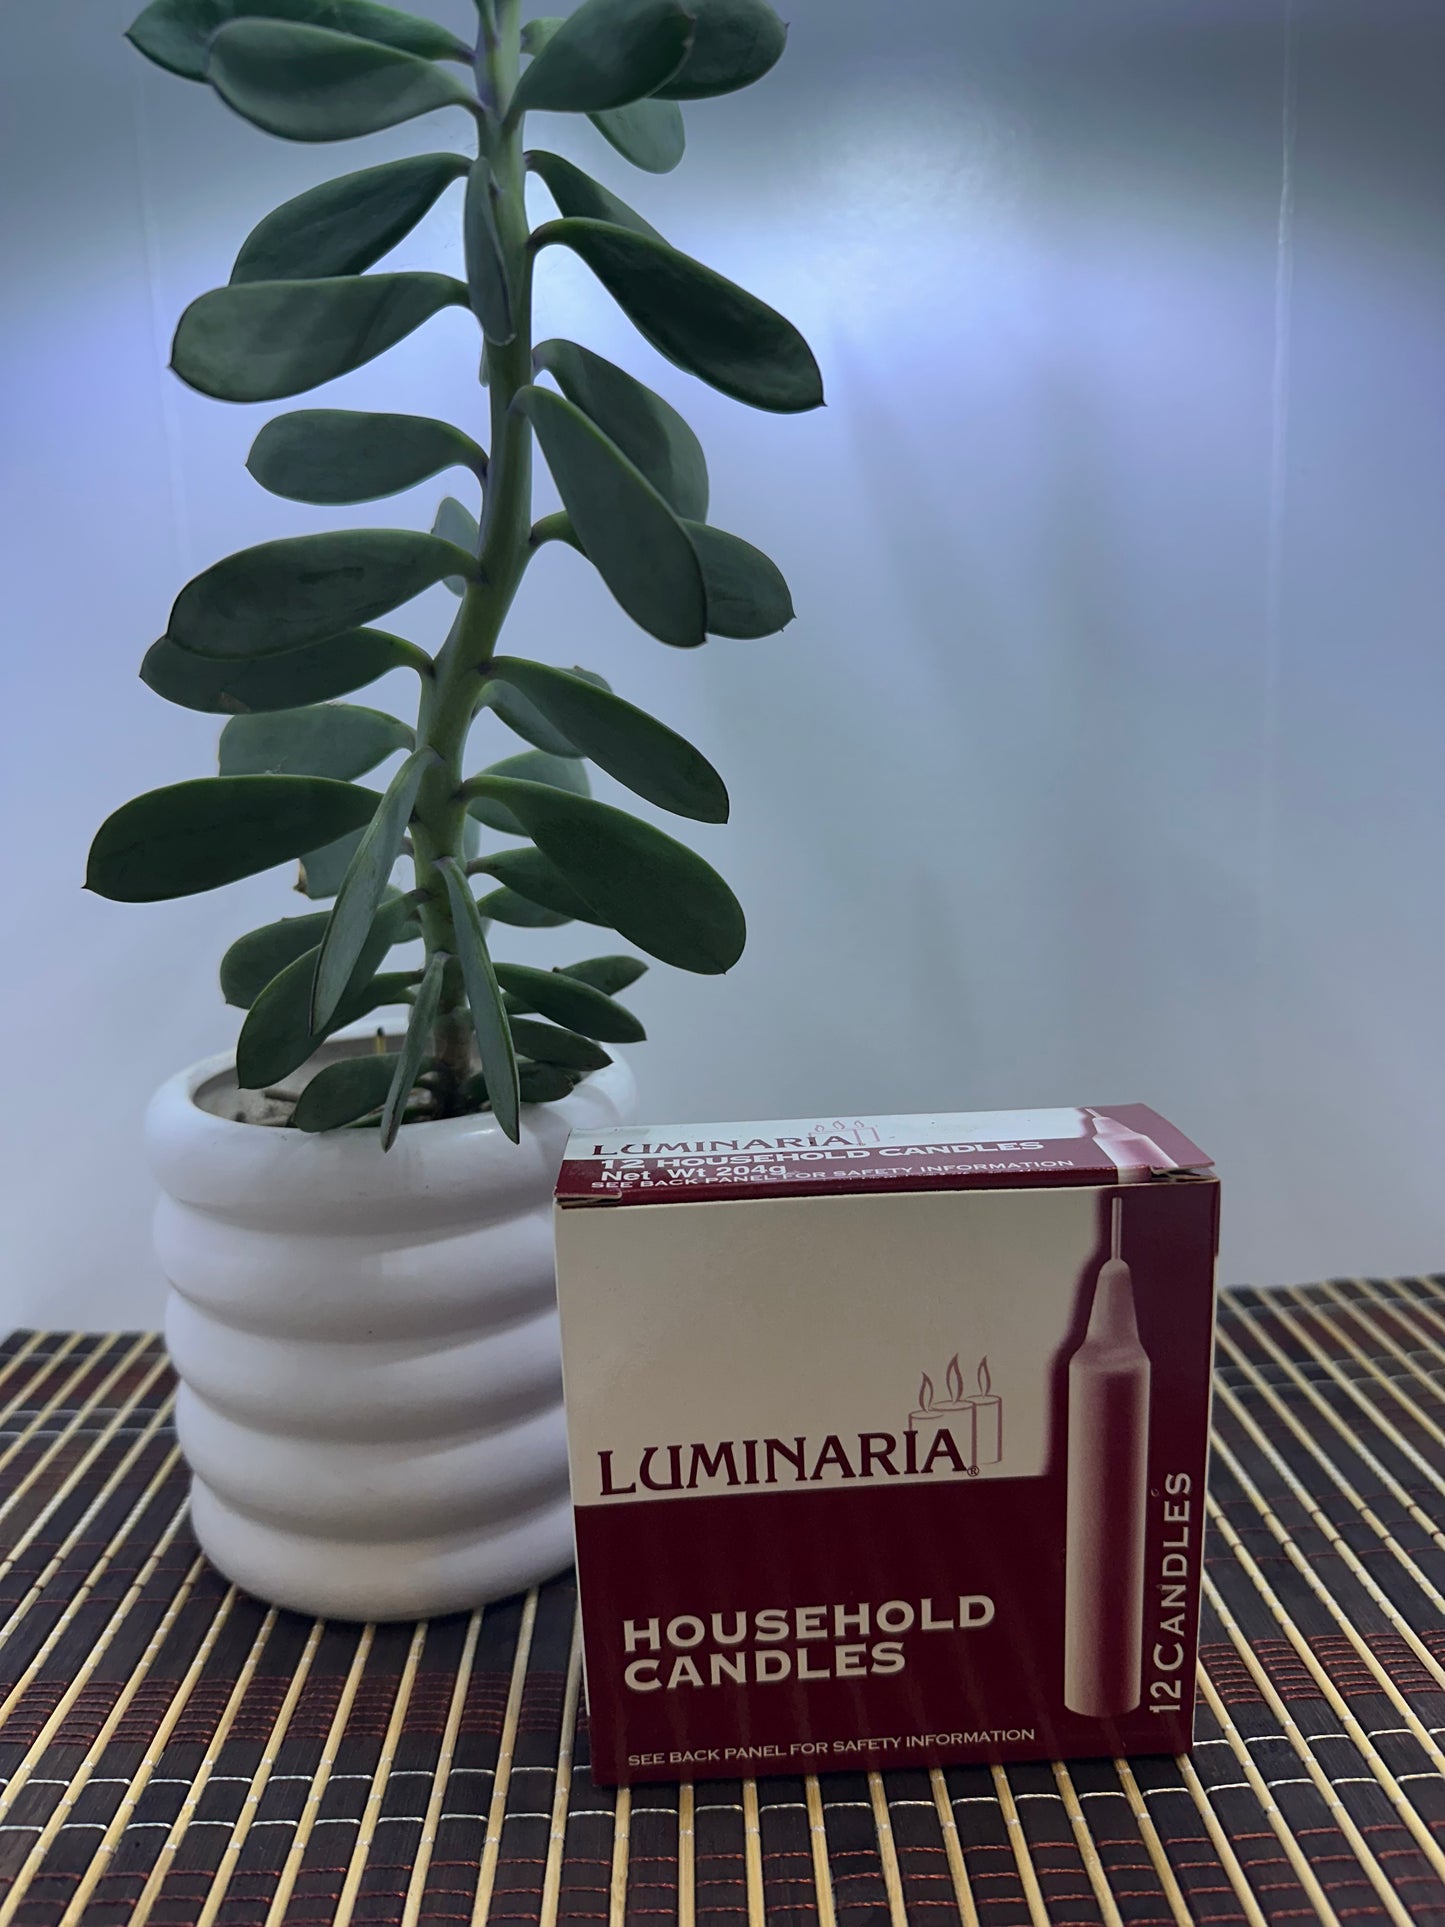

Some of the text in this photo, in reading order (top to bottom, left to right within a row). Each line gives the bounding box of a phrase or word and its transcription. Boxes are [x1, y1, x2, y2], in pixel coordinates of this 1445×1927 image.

[592, 1135, 852, 1155] LUMINARIA
[601, 1141, 1044, 1170] 12 HOUSEHOLD CANDLES
[591, 1160, 1074, 1189] SEE BACK PANEL FOR SAFETY INFORMATION
[601, 1164, 786, 1182] Net Wt 204g
[597, 1428, 967, 1495] LUMINARIA
[1149, 1472, 1192, 1713] 12 CANDLES
[623, 1595, 995, 1652] HOUSEHOLD
[624, 1641, 906, 1692] CANDLES
[628, 1728, 1035, 1766] SEE BACK PANEL FOR SAFETY INFORMATION
